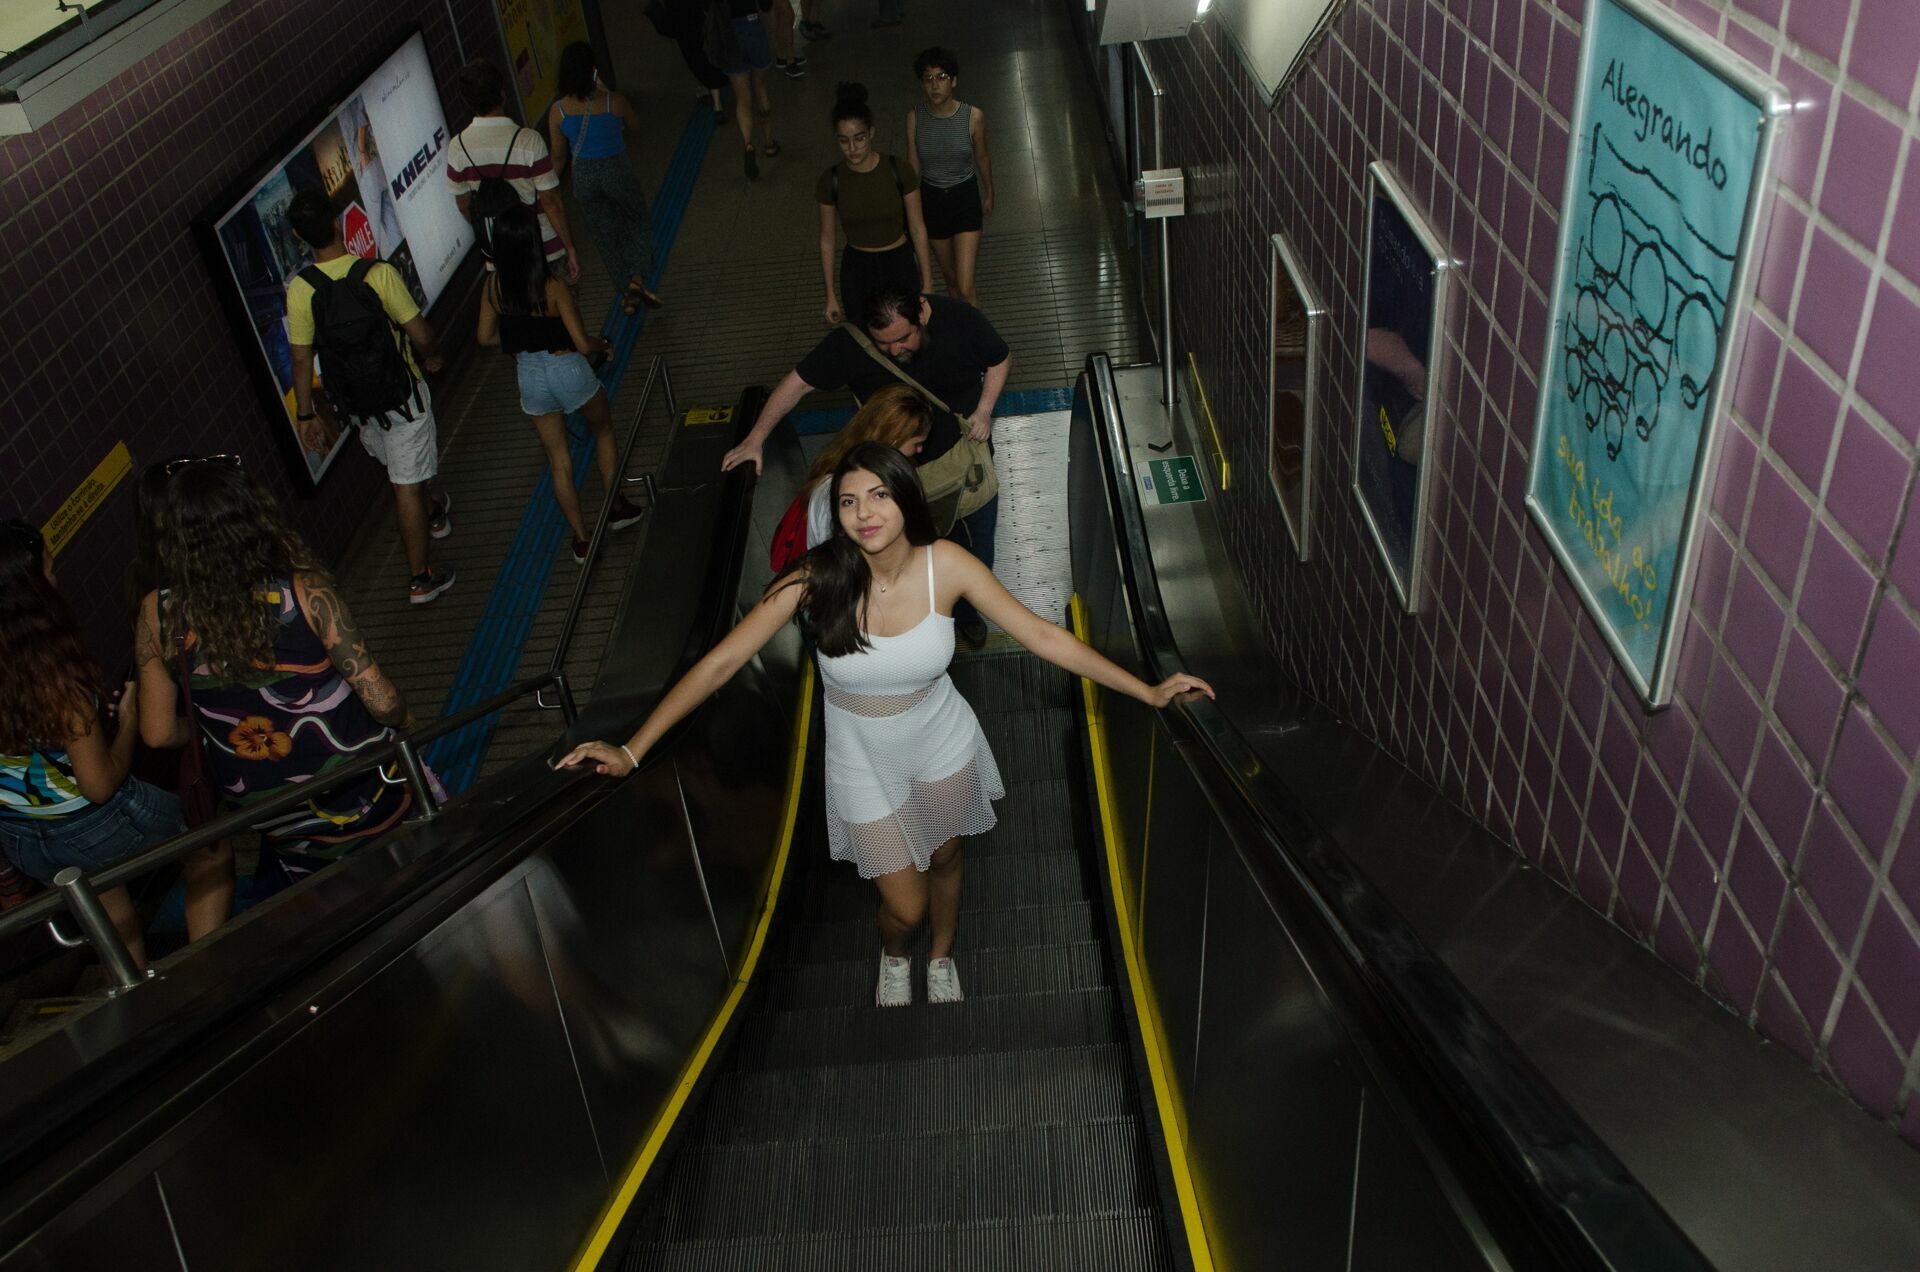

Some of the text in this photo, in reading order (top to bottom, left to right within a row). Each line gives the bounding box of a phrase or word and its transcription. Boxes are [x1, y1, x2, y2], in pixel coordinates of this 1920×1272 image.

[391, 126, 445, 201] KHELF
[1601, 58, 1727, 191] Alegrando
[348, 221, 375, 258] SMILE
[1557, 434, 1657, 591] sua ida ao
[1569, 484, 1652, 630] trabalho!
